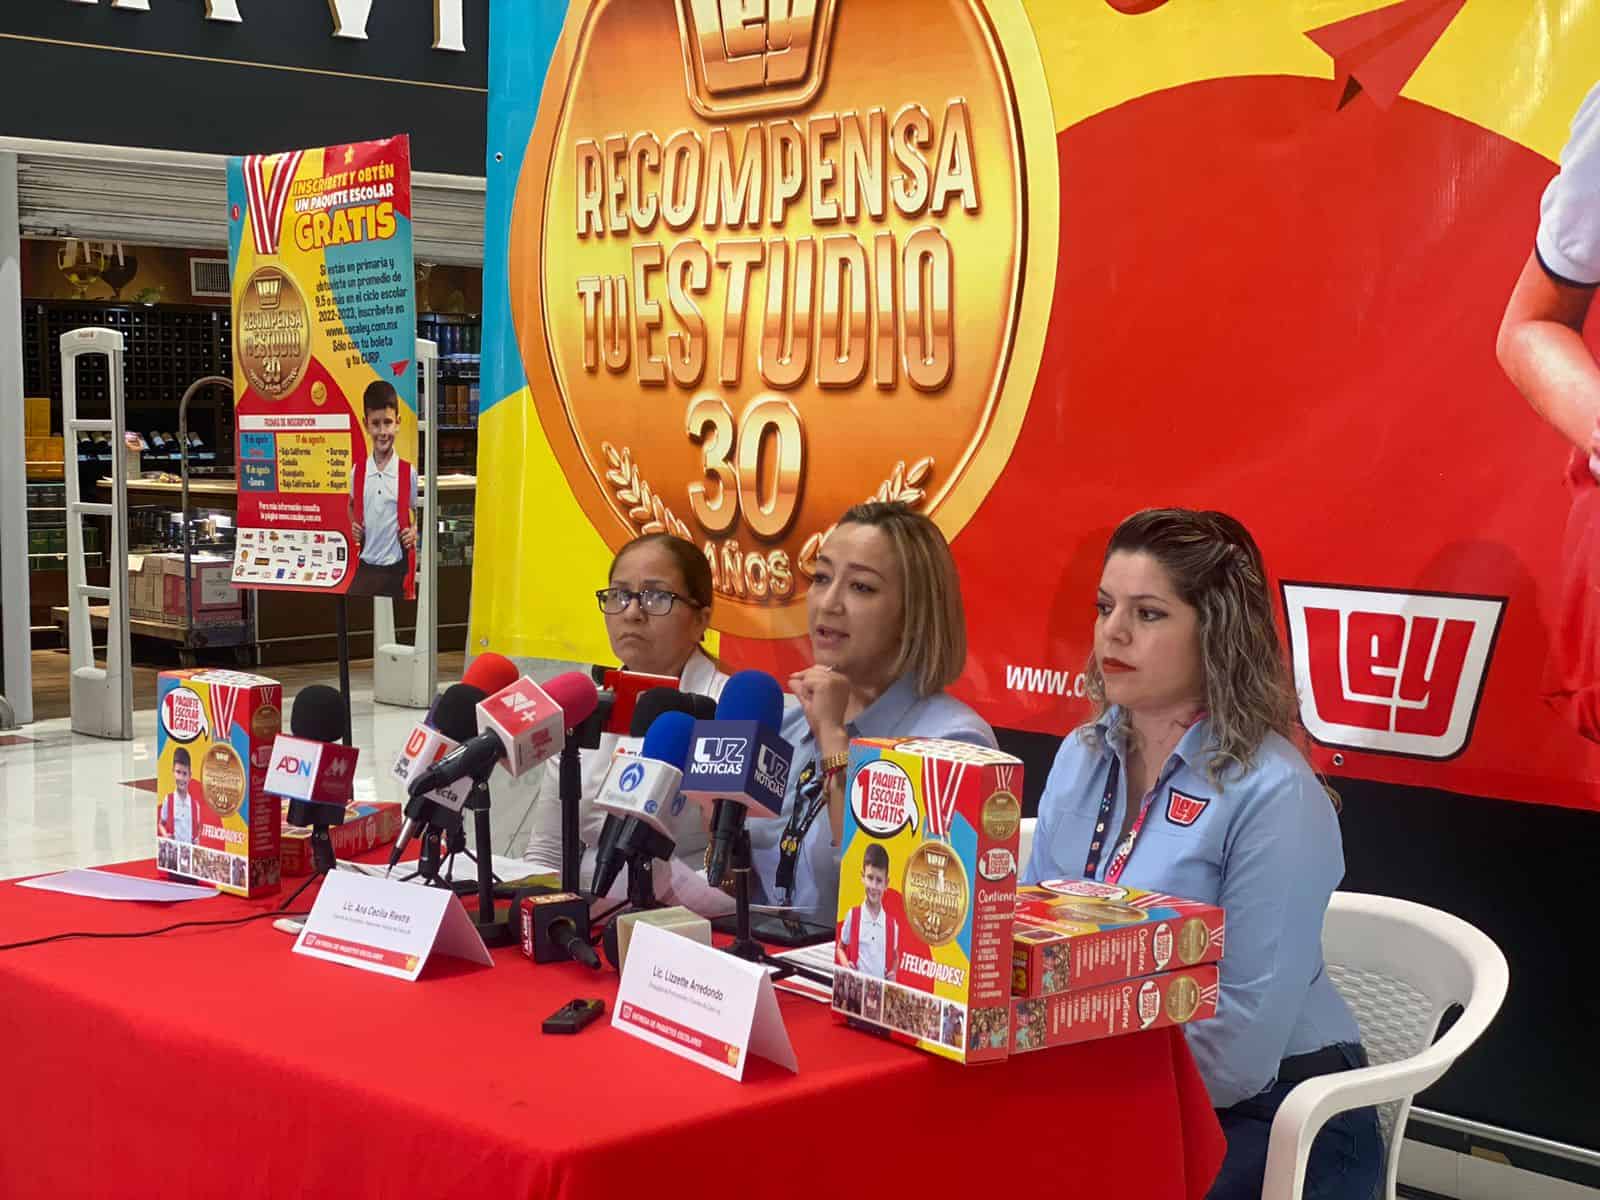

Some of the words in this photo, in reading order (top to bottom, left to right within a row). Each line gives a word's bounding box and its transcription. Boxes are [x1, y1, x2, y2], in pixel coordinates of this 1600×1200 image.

[359, 160, 394, 182] OBTÉN
[575, 96, 981, 239] RECOMPENSA
[295, 196, 309, 212] UN
[310, 190, 348, 210] PAQUETE
[350, 183, 394, 204] ESCOLAR
[295, 202, 396, 251] GRATIS
[357, 258, 388, 274] primaria
[358, 275, 391, 290] promedio
[392, 272, 401, 282] de
[363, 290, 380, 301] ciclo
[381, 287, 407, 300] escolar
[576, 274, 631, 374] TU
[632, 226, 954, 392] ESTUDIO
[370, 335, 393, 348] boleta
[686, 391, 804, 537] 30
[704, 540, 793, 596] AÑOS
[1007, 664, 1087, 698] www.c
[166, 694, 174, 730] 1
[175, 718, 199, 734] GRATIS
[694, 738, 747, 764] LUZ
[756, 743, 789, 784] LUZ
[276, 755, 312, 778] ADN
[690, 763, 742, 775] NOTICIAS
[754, 768, 786, 798] NOTICIAS
[857, 769, 871, 819] 1
[872, 771, 906, 792] PAQUETE
[870, 786, 906, 806] ESCOLAR
[868, 802, 905, 825] GRATIS
[900, 952, 965, 986] ¡FELICIDADES!
[690, 978, 724, 1001] Arredondo
